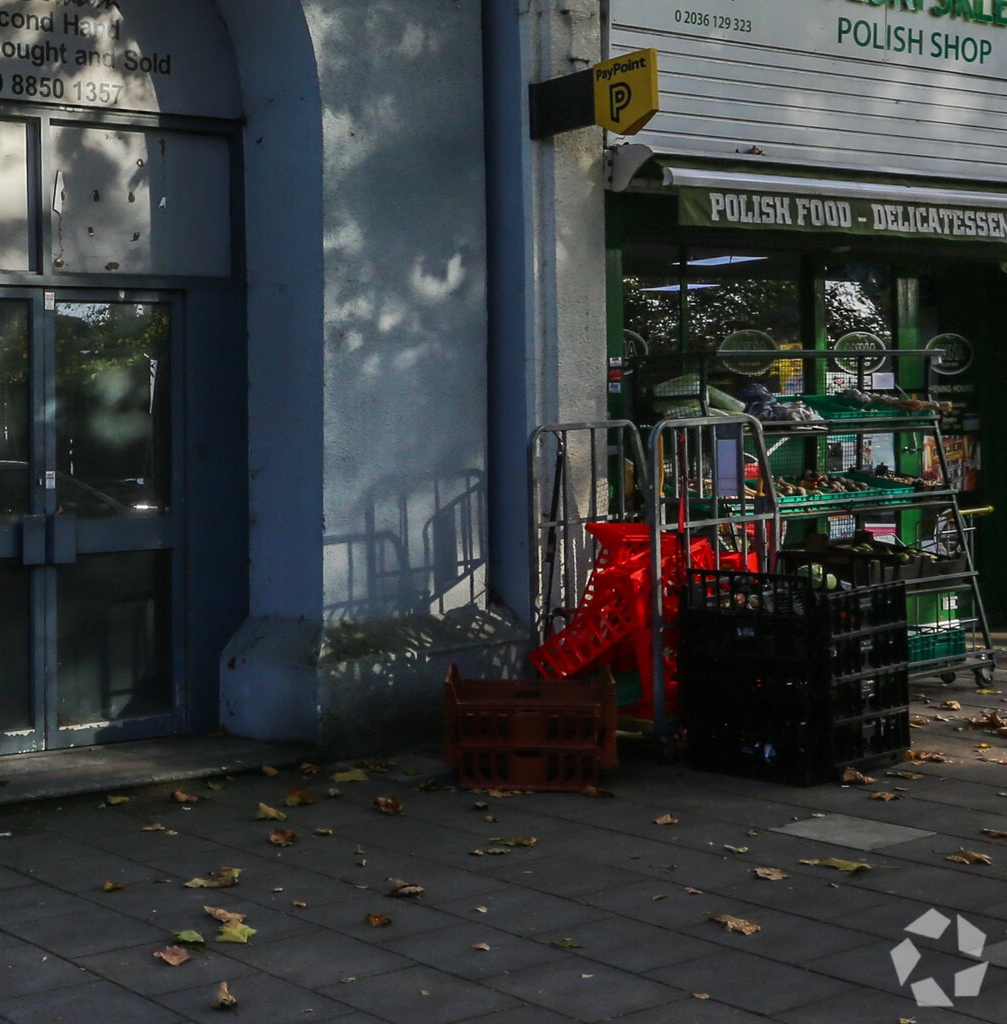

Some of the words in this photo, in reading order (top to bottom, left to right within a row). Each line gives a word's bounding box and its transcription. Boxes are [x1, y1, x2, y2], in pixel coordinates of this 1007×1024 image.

[64, 13, 120, 41] Hand
[675, 9, 682, 22] 0
[684, 11, 710, 27] 2036
[713, 15, 731, 29] 129
[733, 18, 752, 33] 323
[838, 17, 923, 55] POLISH
[930, 32, 992, 64] SHOP
[75, 46, 115, 70] and
[124, 49, 171, 75] Sold
[596, 57, 647, 81] PayPoint
[11, 73, 64, 99] 8850
[73, 80, 123, 105] 1357
[709, 192, 792, 224] POLISH
[795, 198, 852, 228] FOOD
